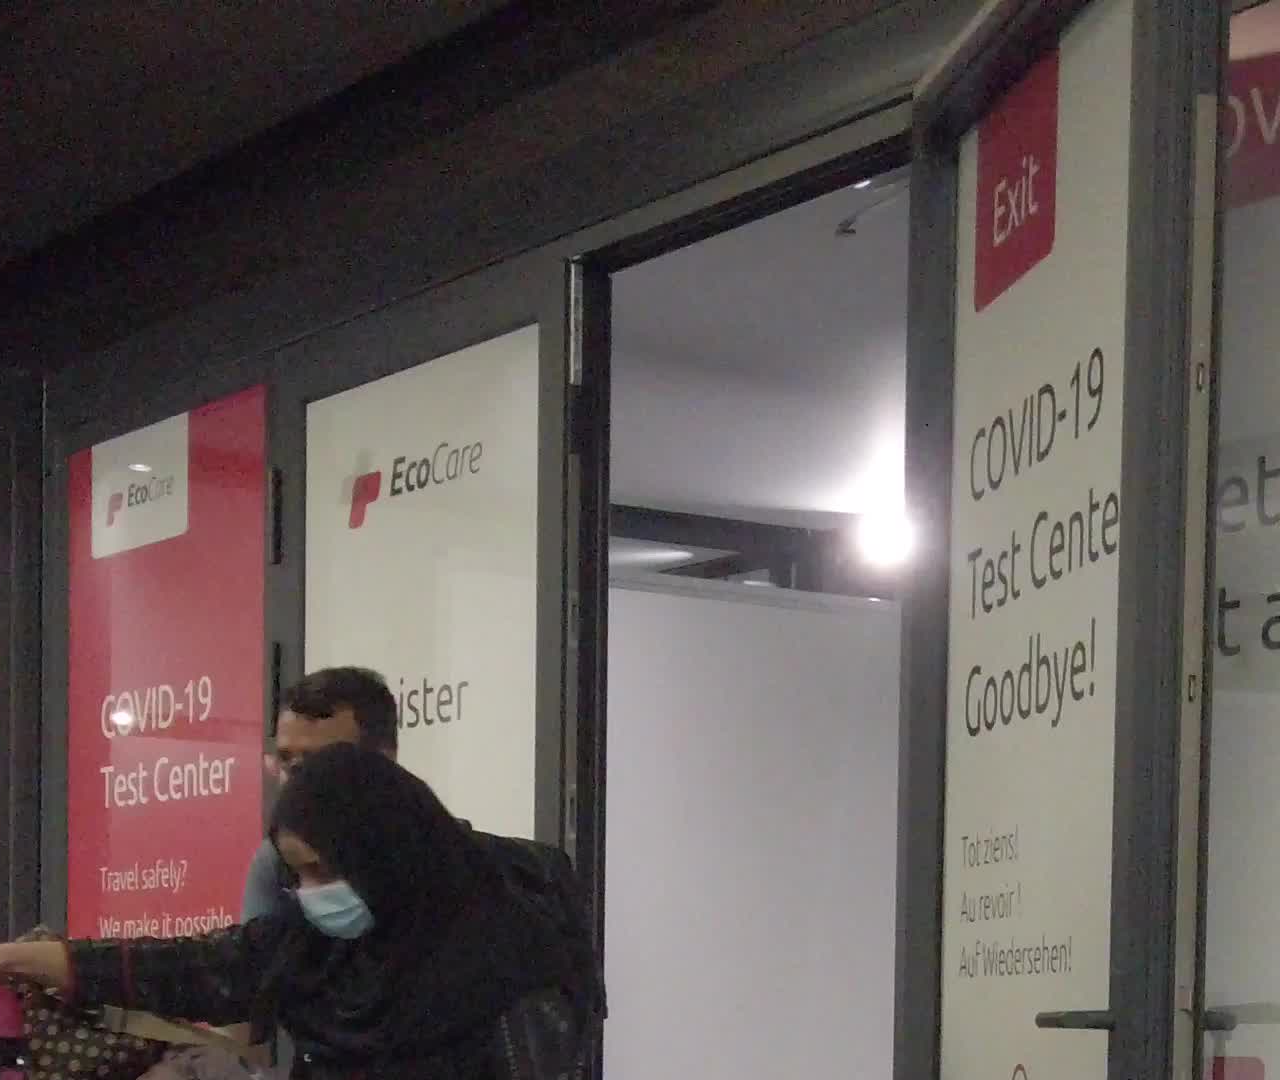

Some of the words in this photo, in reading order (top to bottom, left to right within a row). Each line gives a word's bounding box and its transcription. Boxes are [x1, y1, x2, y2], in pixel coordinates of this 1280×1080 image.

[992, 156, 1040, 248] Exit
[970, 346, 1105, 502] COVID-19
[389, 440, 484, 497] EcoCare
[967, 530, 1021, 620] Test
[1030, 487, 1119, 592] Cente
[965, 617, 1097, 738] Goodbye!
[100, 675, 213, 739] COVID-19
[100, 764, 148, 809] Test
[154, 756, 236, 801] Center
[961, 834, 981, 869] Tot
[983, 824, 1019, 865] ziens!
[100, 861, 139, 892] Travel
[141, 858, 188, 893] safely?
[100, 915, 121, 938] We
[123, 911, 160, 939] make
[162, 912, 173, 939] it
[960, 892, 976, 923] Au
[979, 884, 1015, 921] revoir
[959, 939, 982, 978] Auf
[982, 935, 1072, 976] Wiedersehen!
